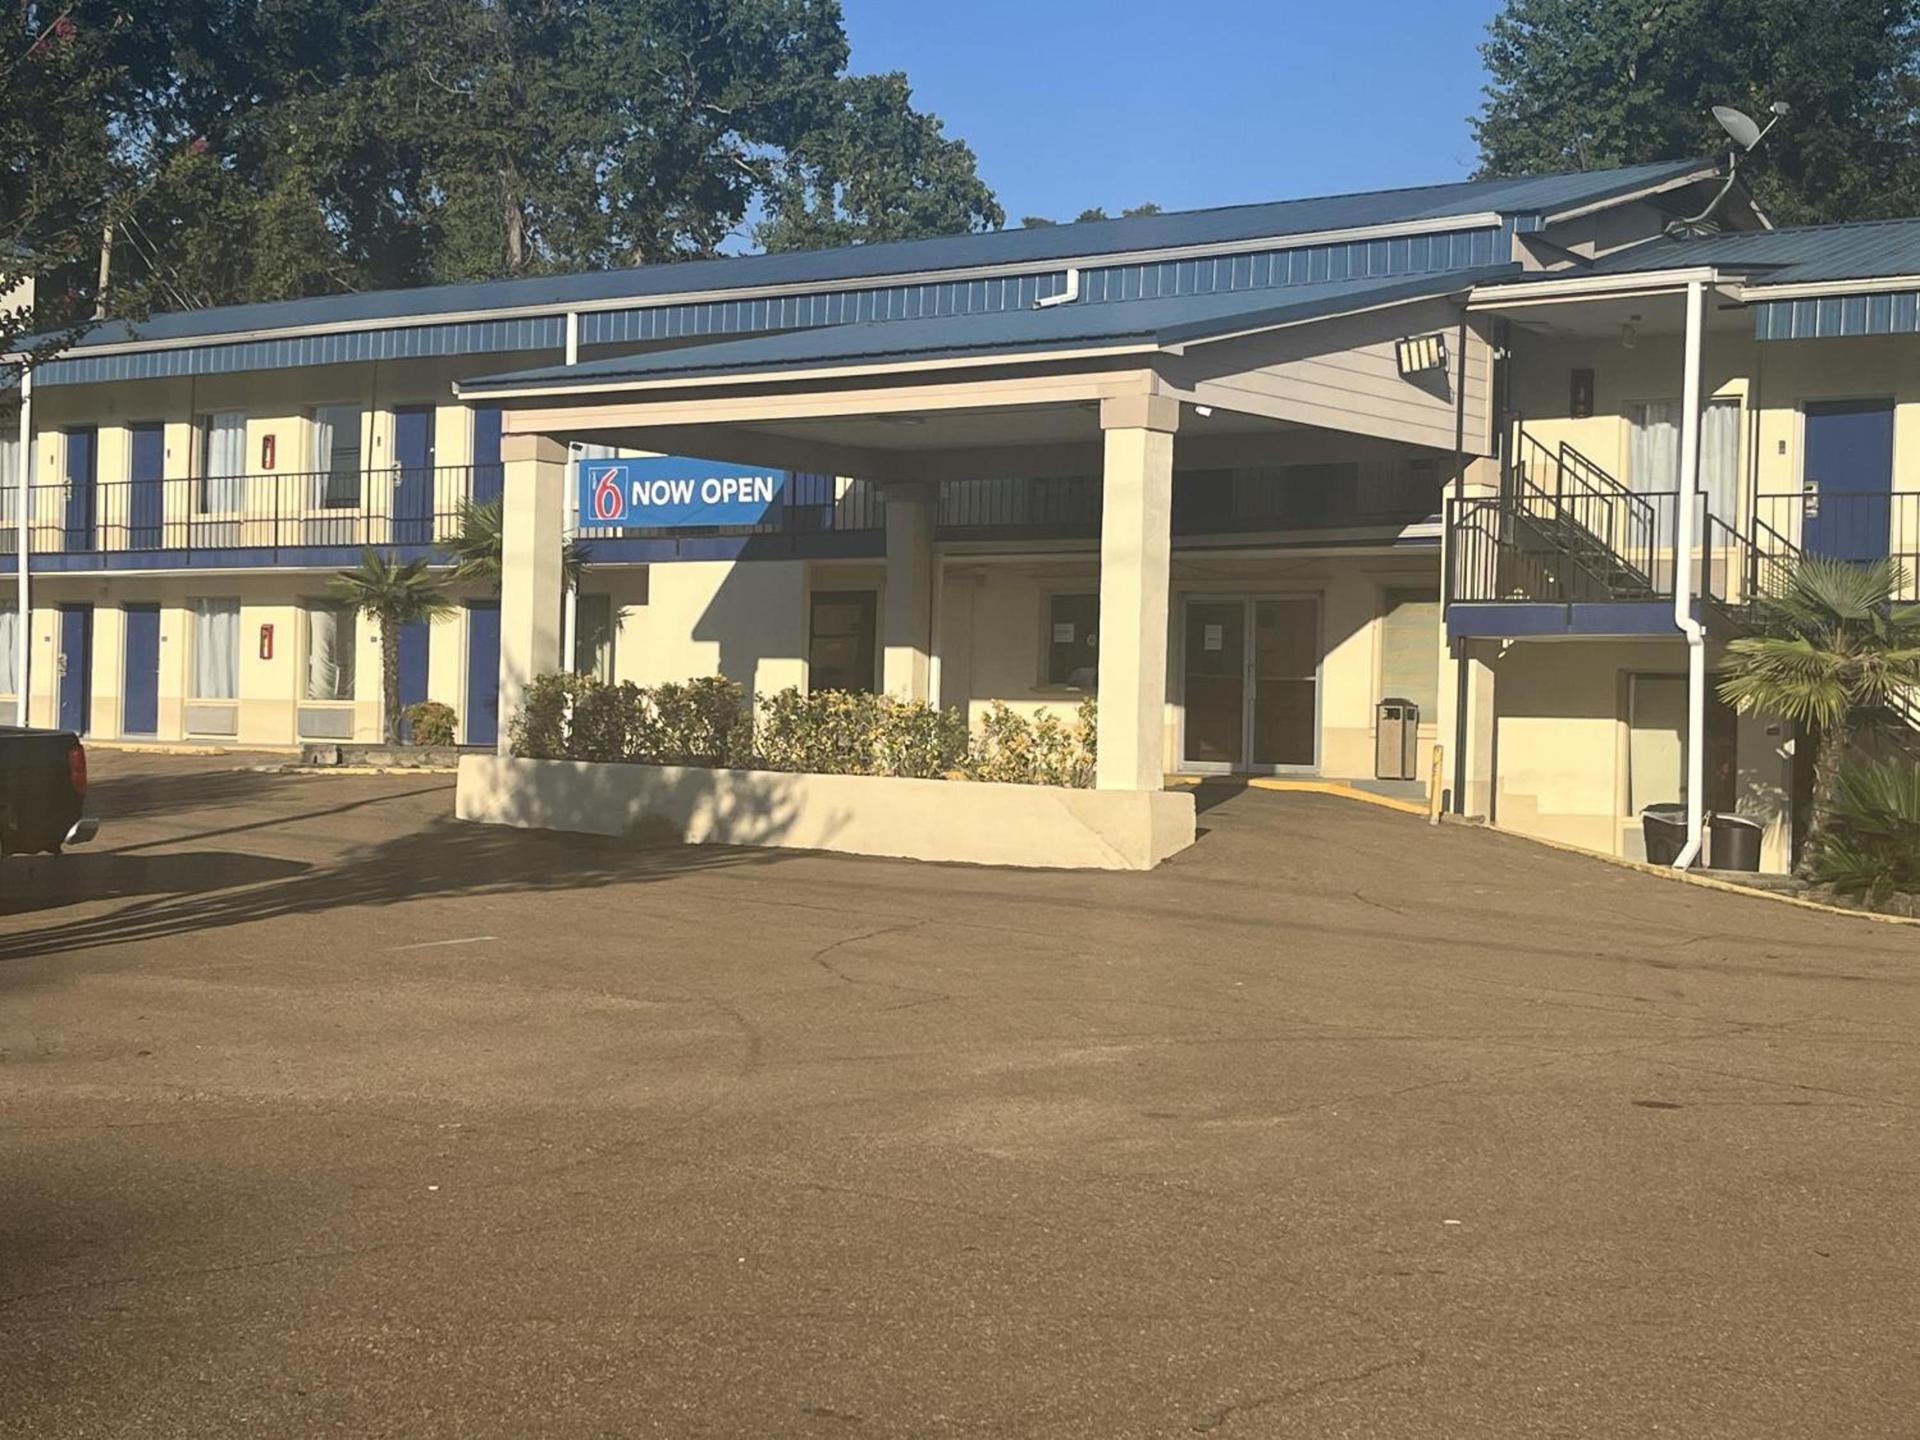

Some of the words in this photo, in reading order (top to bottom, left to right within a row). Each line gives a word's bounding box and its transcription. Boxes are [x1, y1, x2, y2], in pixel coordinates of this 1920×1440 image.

[595, 468, 623, 520] 6
[631, 480, 695, 506] NOW
[701, 476, 773, 504] OPEN
